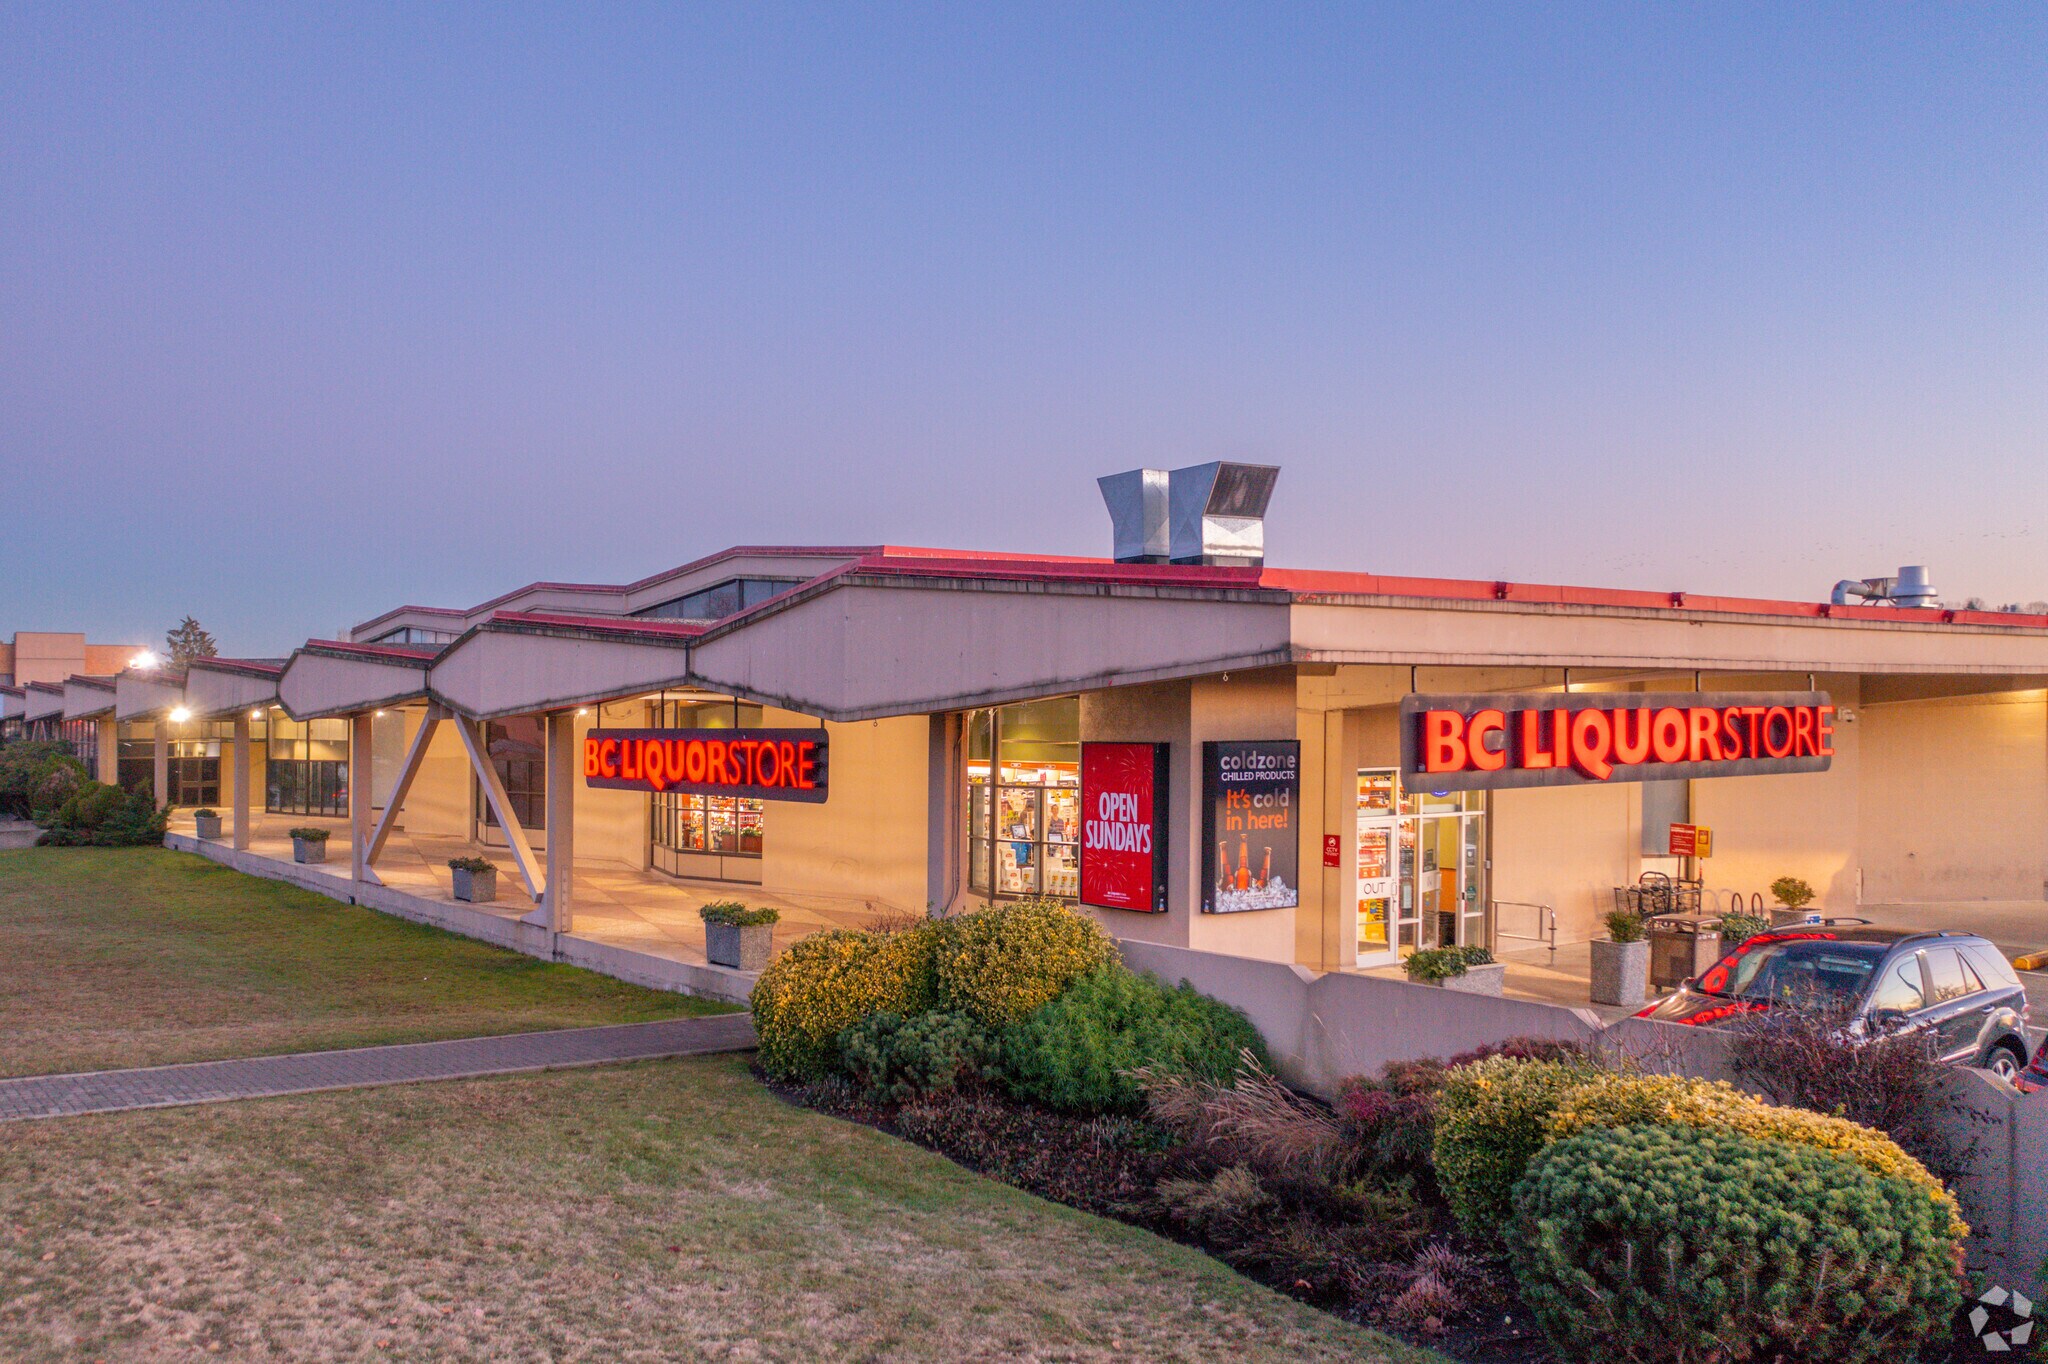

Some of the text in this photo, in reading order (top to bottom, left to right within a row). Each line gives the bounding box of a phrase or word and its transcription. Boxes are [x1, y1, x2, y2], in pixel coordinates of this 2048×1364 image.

[1426, 709, 1505, 773] BC
[584, 738, 615, 778] BC
[1220, 750, 1296, 770] coldzone
[1221, 770, 1295, 781] CHILLED PRODUCTS
[1100, 791, 1138, 822] OPEN
[1226, 787, 1289, 809] It's cold
[1226, 807, 1288, 831] in here!
[1085, 820, 1150, 854] SUNDAYS
[1363, 882, 1386, 895] OUT
